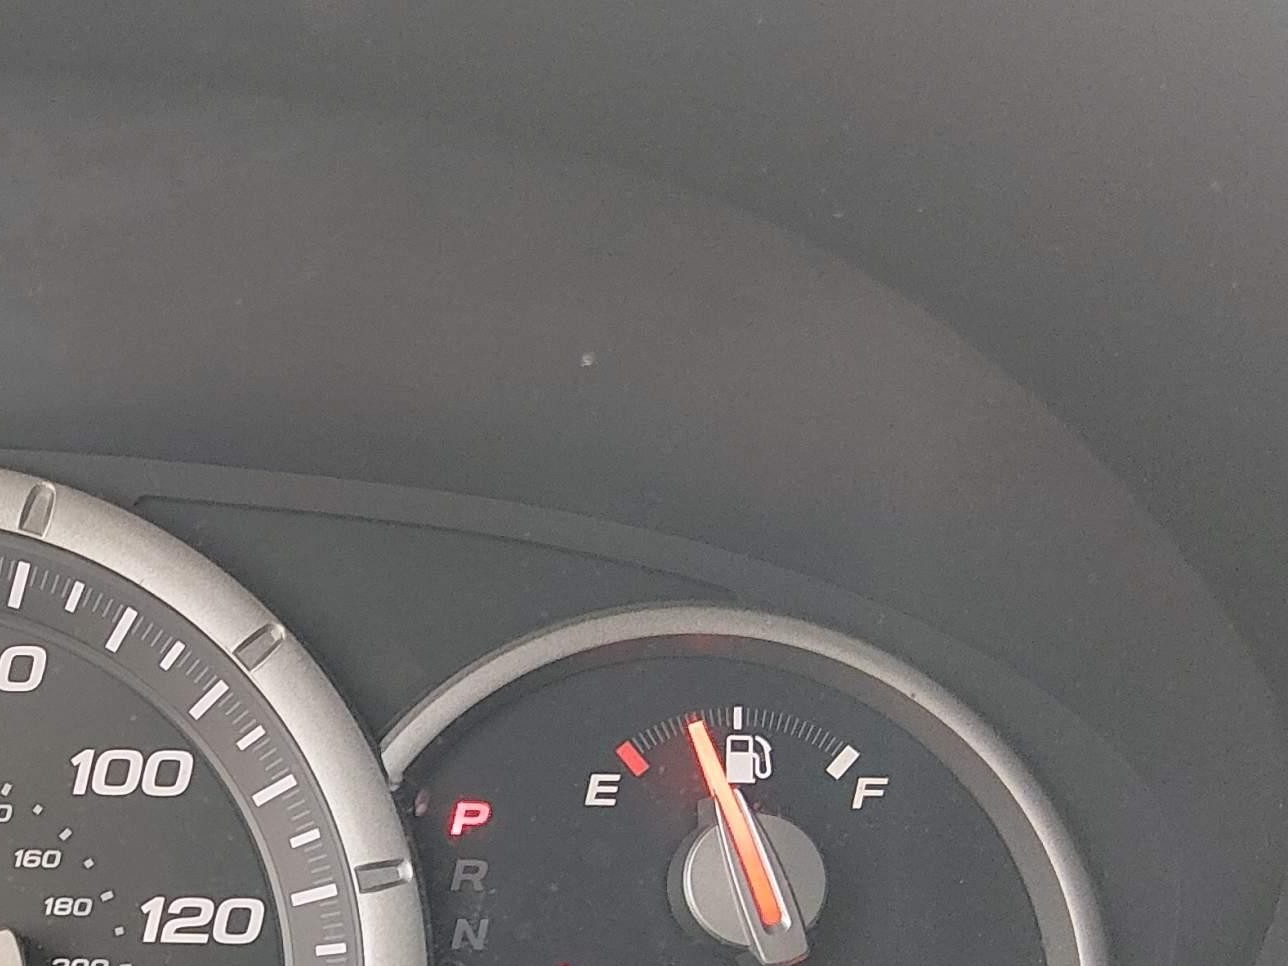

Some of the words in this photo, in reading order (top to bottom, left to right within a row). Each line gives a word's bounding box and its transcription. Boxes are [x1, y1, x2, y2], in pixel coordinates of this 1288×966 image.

[70, 749, 194, 797] 100
[584, 773, 621, 806] E
[852, 777, 889, 809] F
[450, 801, 491, 836] P
[14, 849, 62, 868] 160
[450, 858, 489, 891] R
[44, 897, 93, 916] 180
[140, 896, 265, 945] 120
[450, 918, 489, 951] N
